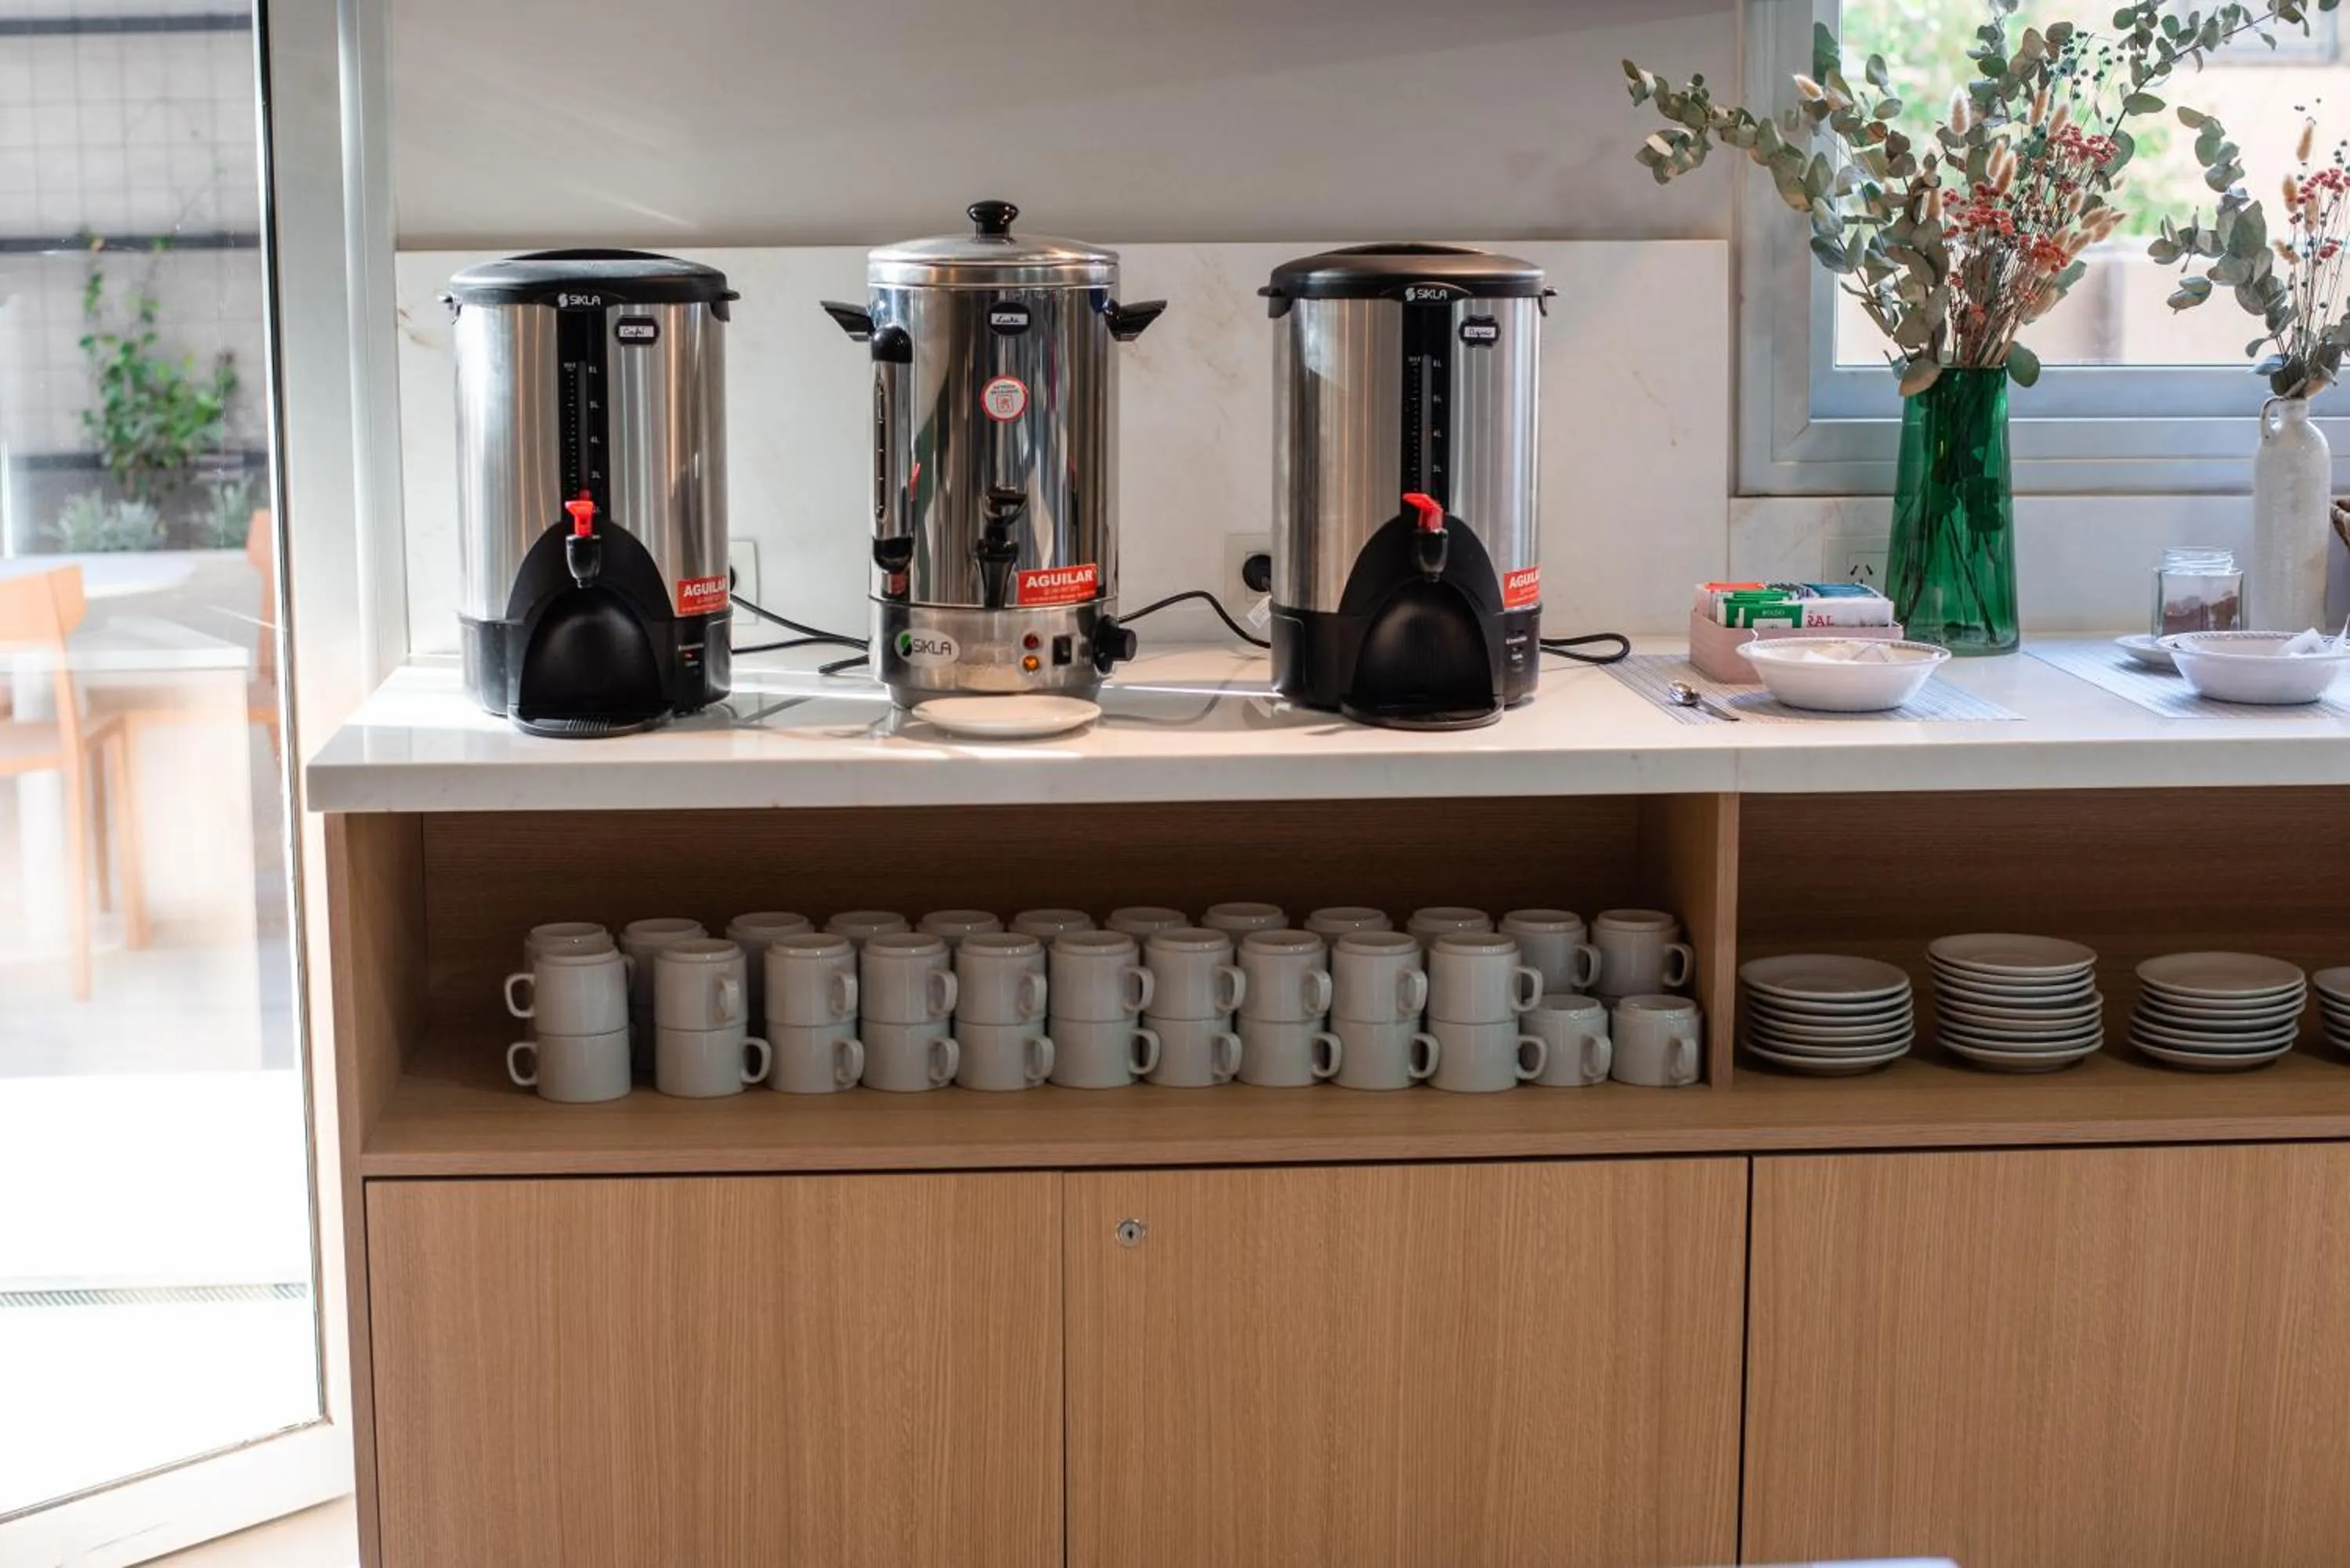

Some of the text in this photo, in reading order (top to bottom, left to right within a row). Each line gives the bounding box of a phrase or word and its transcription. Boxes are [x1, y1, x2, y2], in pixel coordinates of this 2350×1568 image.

[569, 294, 601, 305] SIKLA
[1416, 289, 1448, 299] SIKLA
[1025, 569, 1094, 588] AGUILAR
[913, 638, 952, 656] SIKLA
